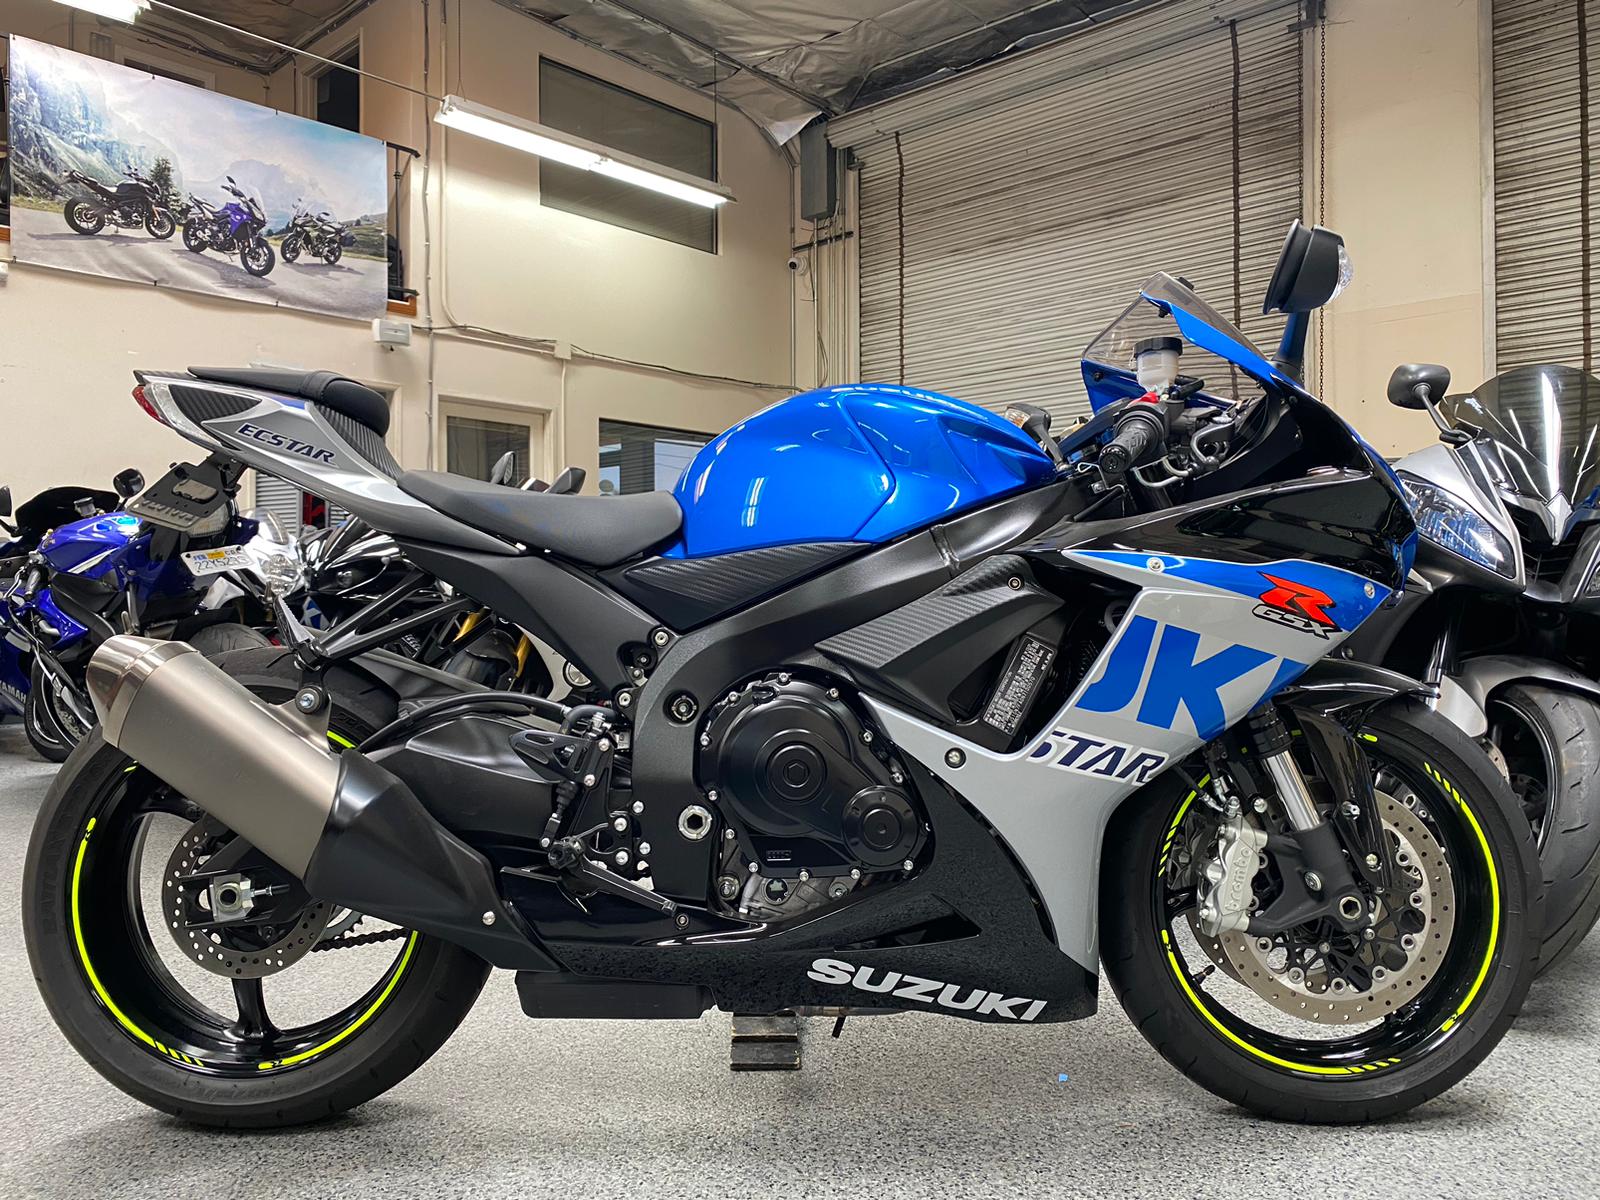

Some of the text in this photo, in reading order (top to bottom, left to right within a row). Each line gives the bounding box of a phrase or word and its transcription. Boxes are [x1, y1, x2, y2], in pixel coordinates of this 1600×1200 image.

[236, 423, 337, 466] ECSTAR
[1252, 604, 1342, 640] GSX
[1225, 848, 1253, 912] brembo
[807, 958, 1047, 1021] SUZUKI
